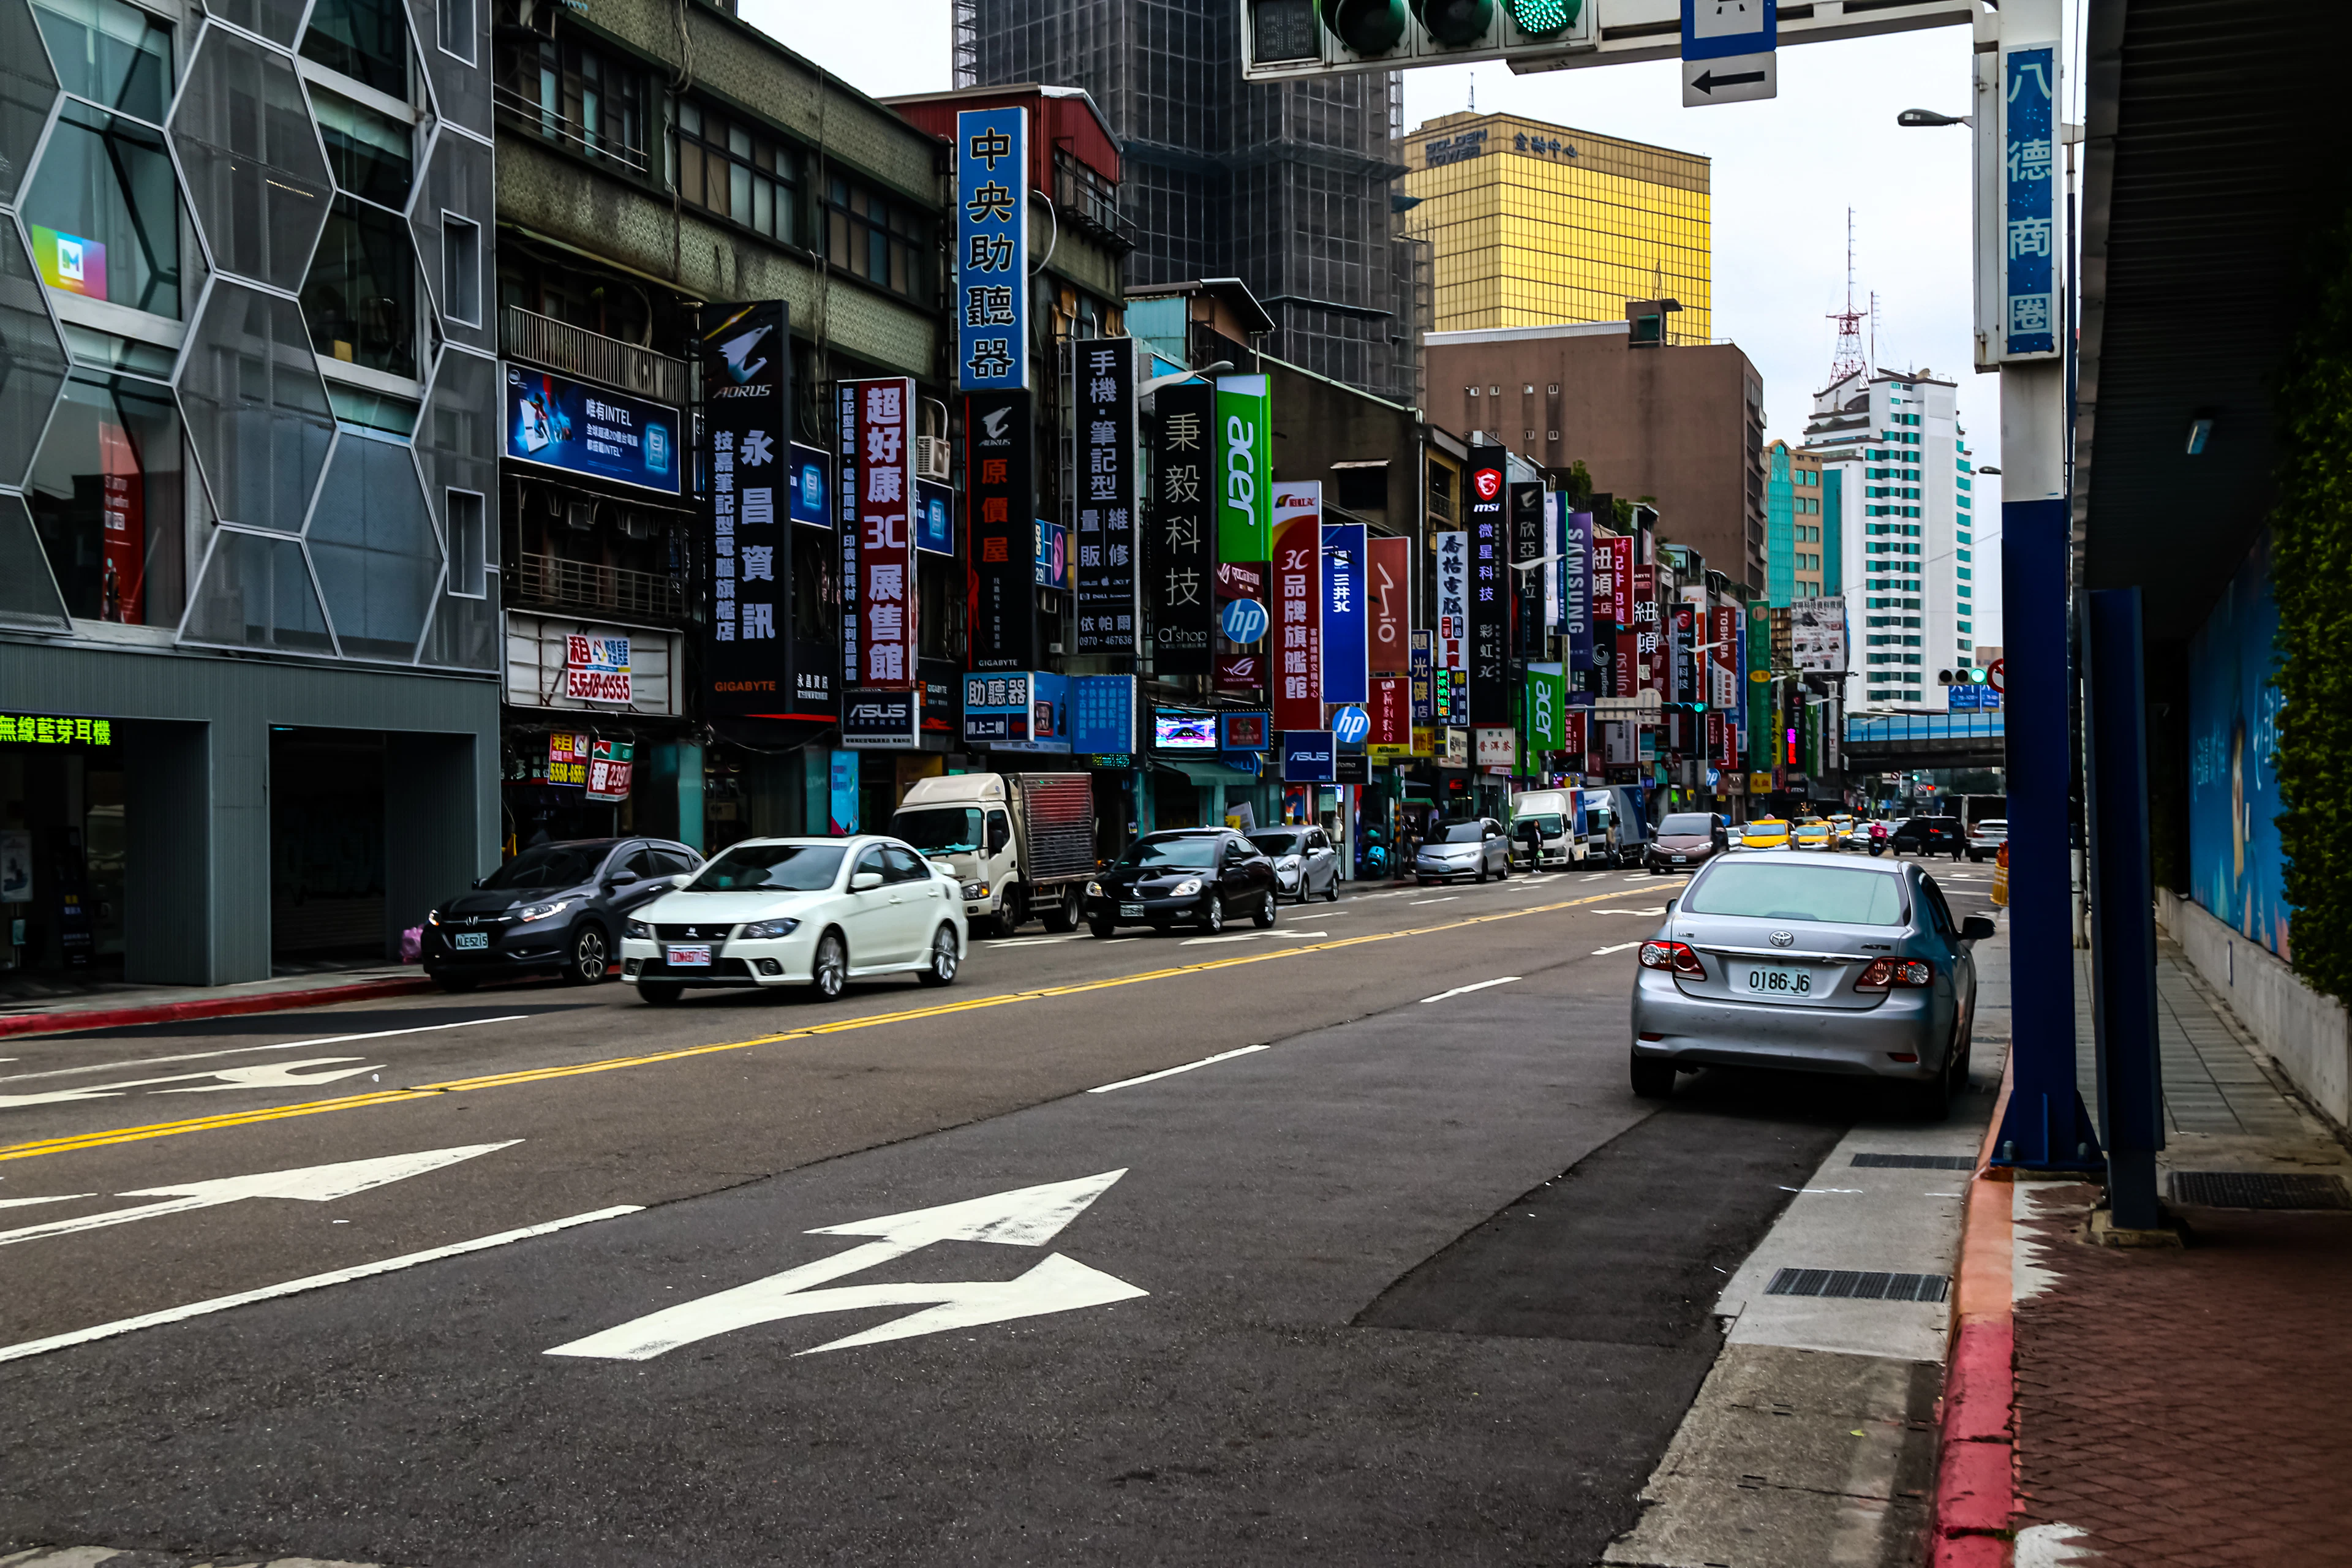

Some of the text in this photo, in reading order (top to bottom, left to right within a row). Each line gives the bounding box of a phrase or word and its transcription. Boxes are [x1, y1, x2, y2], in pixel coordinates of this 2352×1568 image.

[1425, 129, 1487, 154] GOLDEN
[1425, 145, 1480, 167] TOWER
[1513, 132, 1578, 159] 金融中心
[2008, 62, 2052, 335] 八德商圈
[966, 126, 1016, 380] 中央助聽器
[713, 384, 772, 398] AORUS
[1227, 415, 1255, 526] acer
[981, 459, 1009, 564] 原價屋
[1165, 413, 1201, 606] 秉毅科技
[1474, 503, 1500, 513] msi
[714, 431, 735, 641] 技嘉筆記型電腦旗艦店
[740, 429, 775, 639] 永昌資訊
[864, 387, 906, 680] 超好康3C展售館
[1080, 509, 1101, 567] 量販
[1108, 507, 1129, 567] 維修
[1479, 523, 1494, 602] 微星科技
[1080, 614, 1131, 632] 依帕爾
[1227, 600, 1261, 643] hp
[568, 636, 592, 663] 租
[1079, 637, 1098, 646] 0970
[1104, 635, 1133, 644] 467636
[1478, 624, 1495, 678] 彩虹3C
[978, 659, 1019, 669] GIGABYTE
[714, 680, 776, 692] GIGABYTE
[968, 679, 1027, 706] 助聽器
[849, 704, 907, 718] ASUS
[1336, 706, 1365, 743] hp
[1535, 680, 1552, 743] acer
[0, 715, 111, 746] 無線藍芽耳機
[552, 734, 573, 751] 租
[1289, 752, 1330, 761] ASUS
[1377, 745, 1400, 754] Nikon
